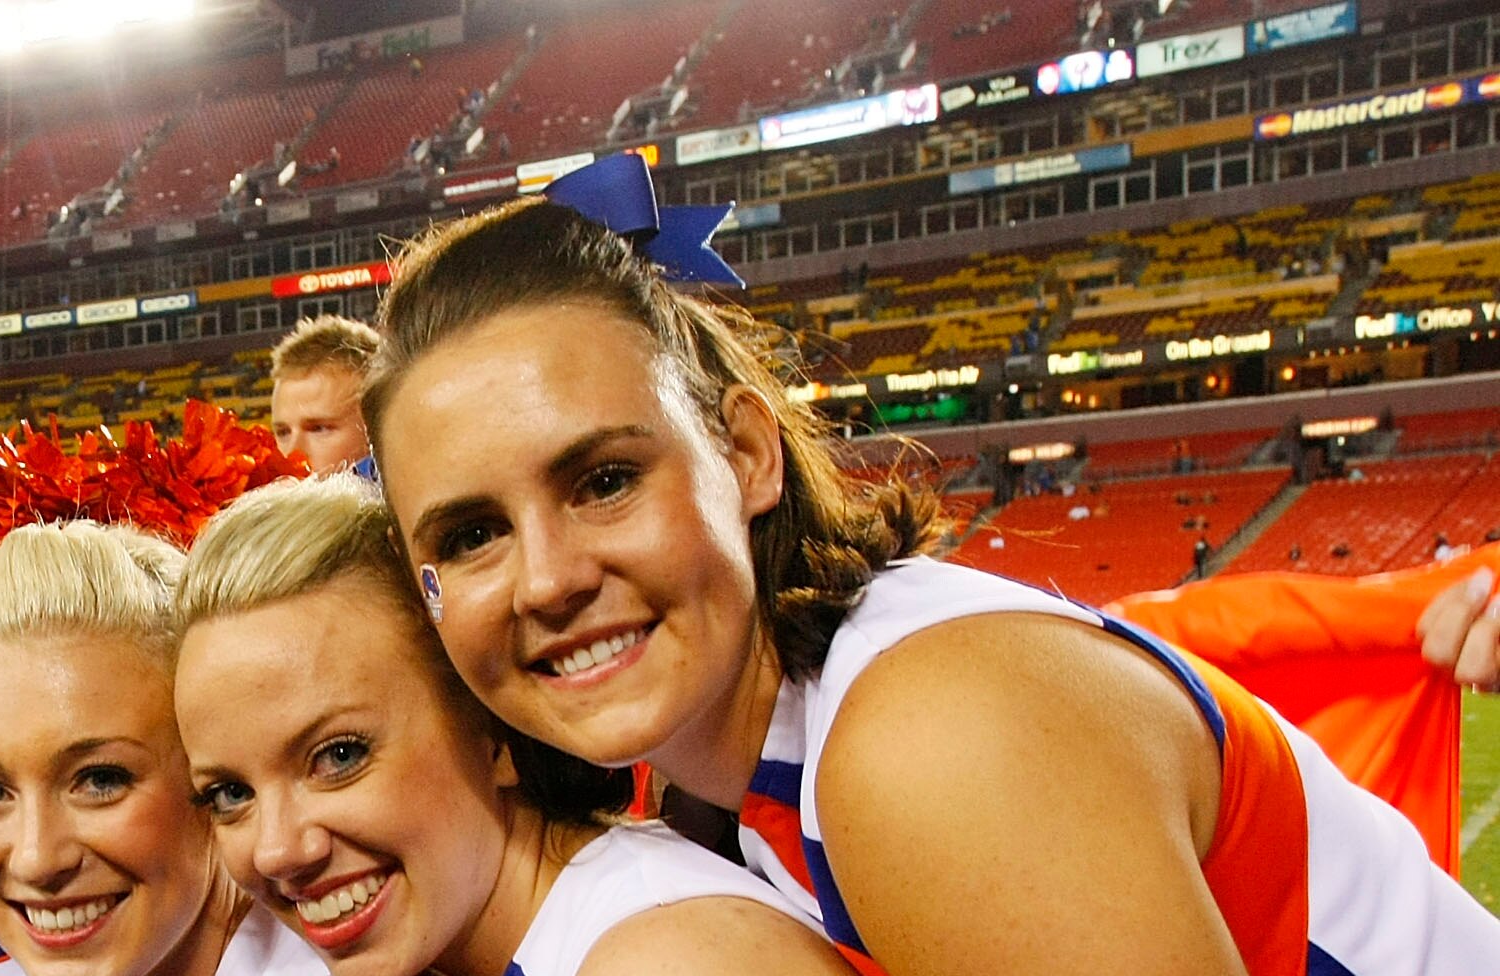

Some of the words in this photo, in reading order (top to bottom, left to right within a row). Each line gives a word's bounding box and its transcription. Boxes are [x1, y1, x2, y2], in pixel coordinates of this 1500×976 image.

[1160, 36, 1220, 65] Trex
[1291, 88, 1427, 134] MasterCard
[319, 268, 372, 288] TOYOTA
[84, 303, 128, 319] GEICO
[1417, 307, 1473, 332] Office
[1166, 341, 1188, 361] On
[1212, 331, 1271, 355] Ground
[886, 370, 936, 392] Through
[959, 364, 980, 385] Air
